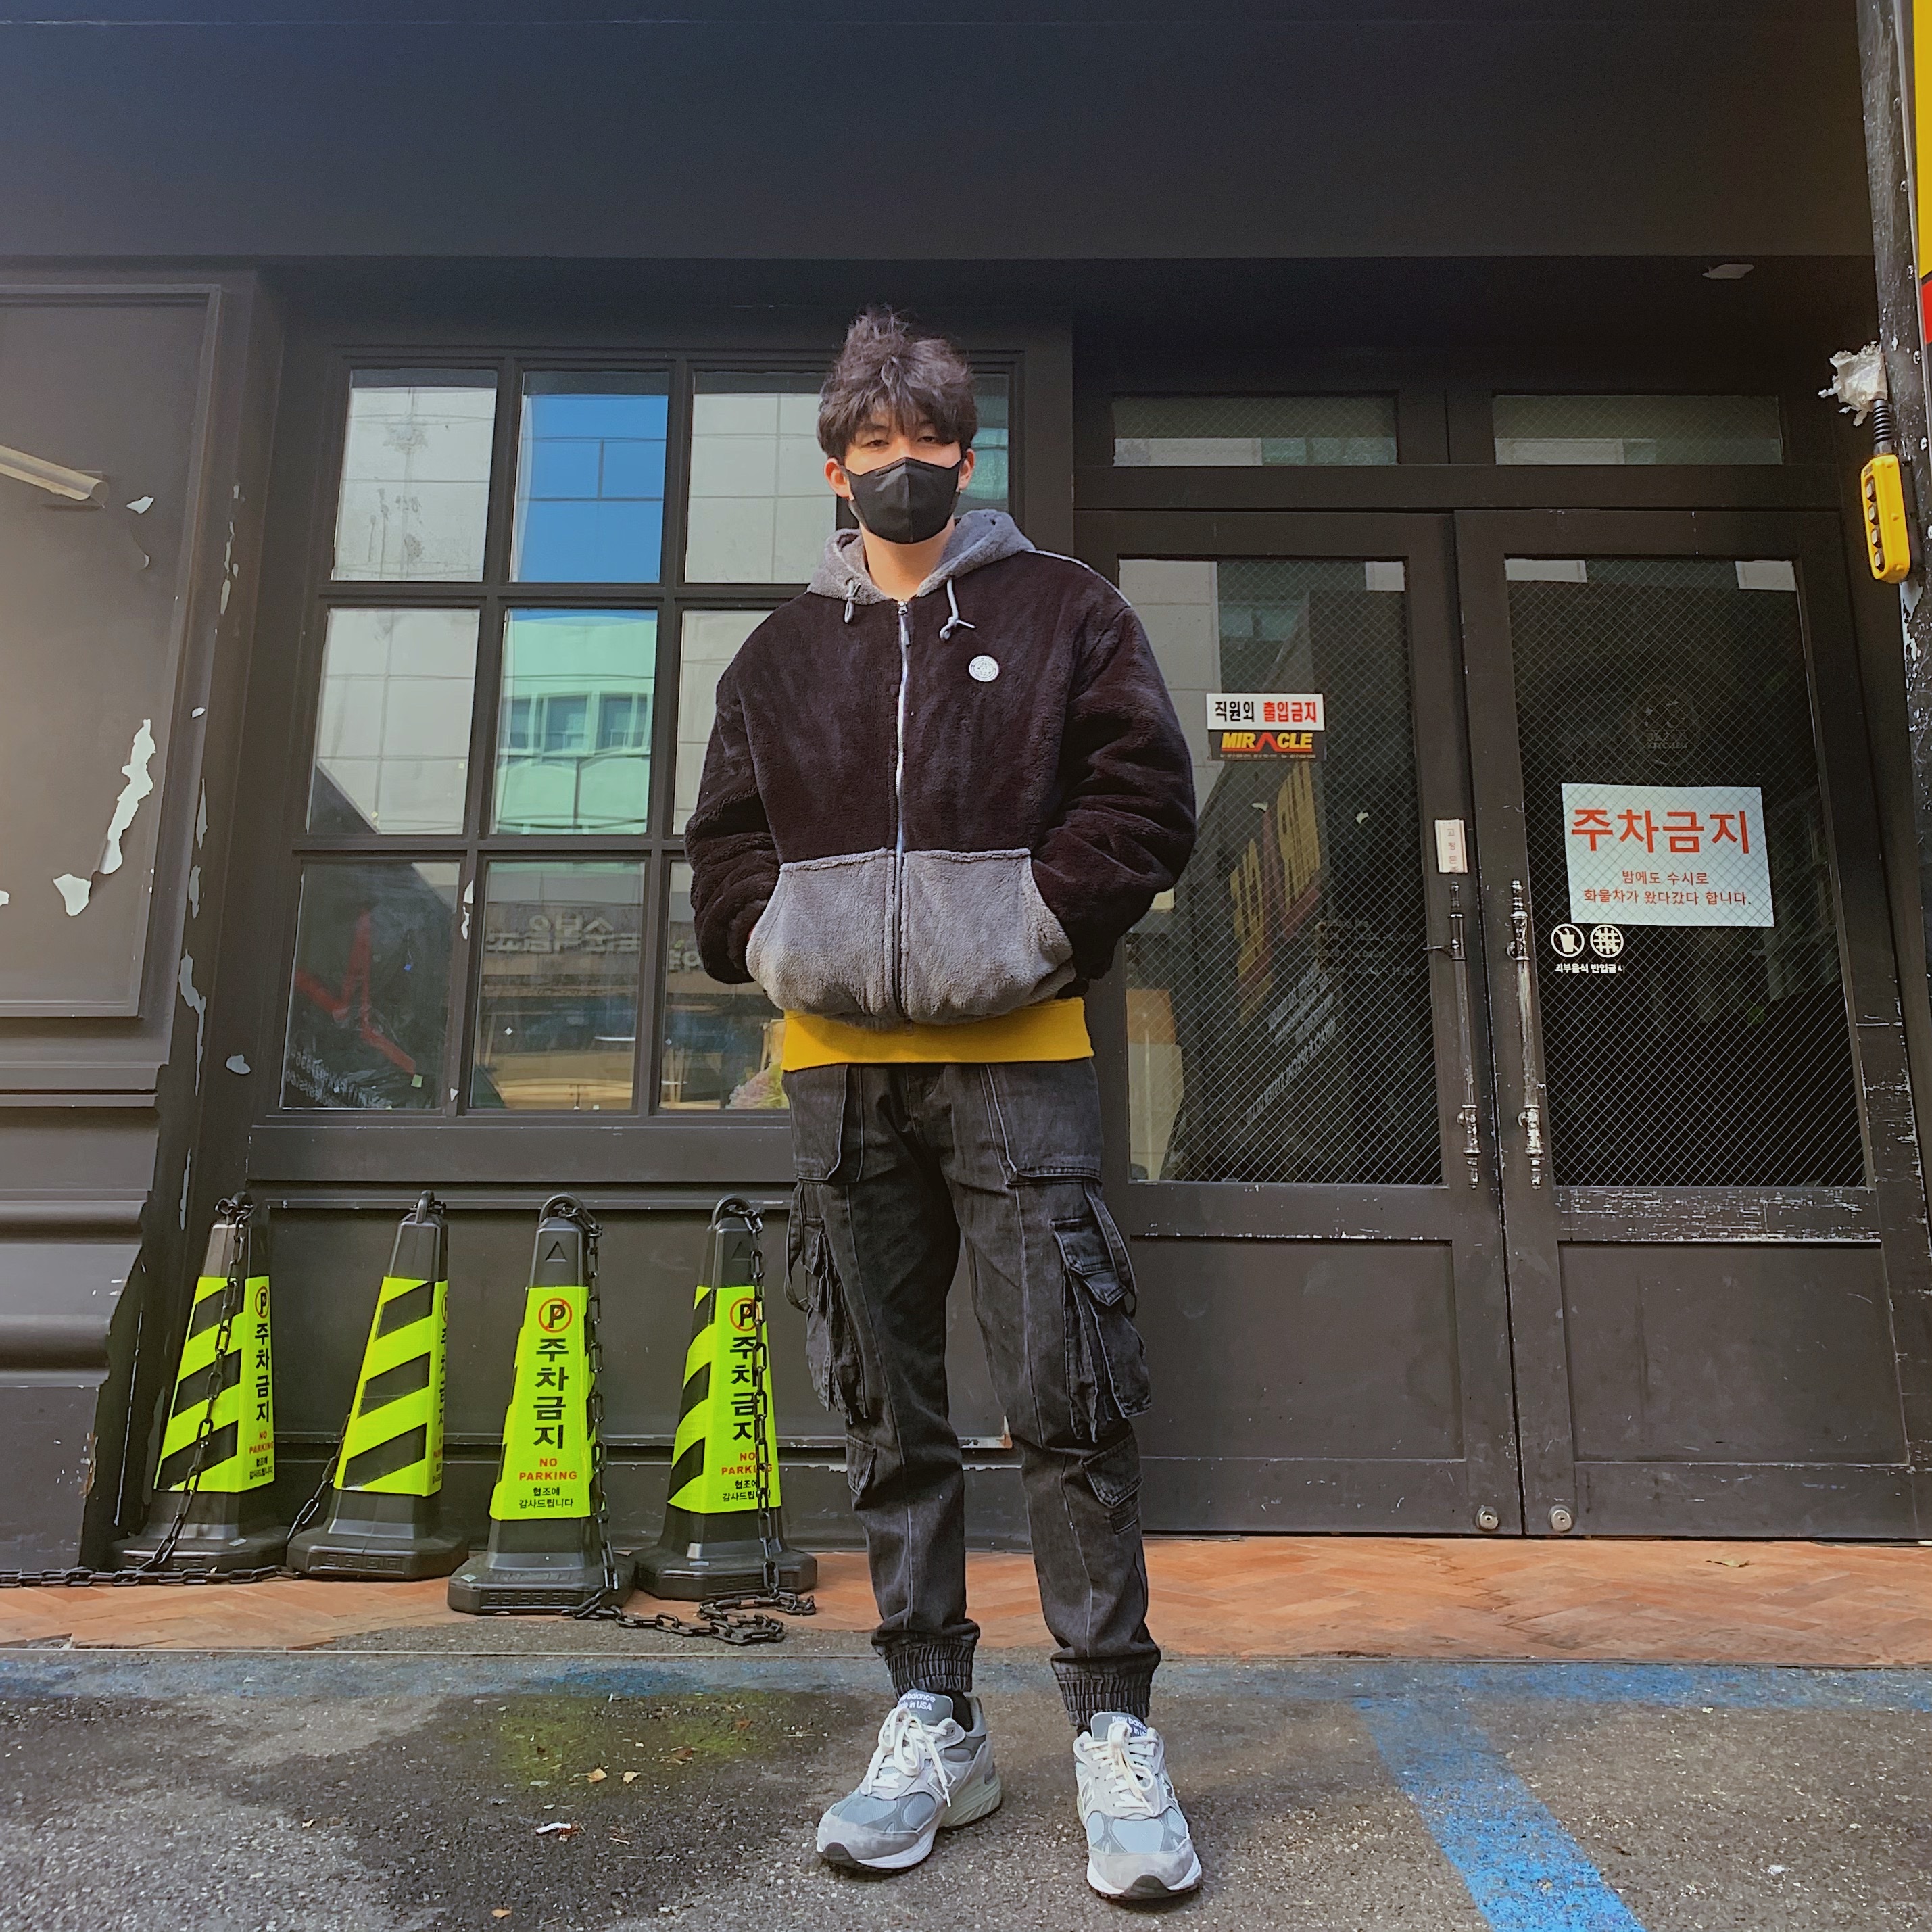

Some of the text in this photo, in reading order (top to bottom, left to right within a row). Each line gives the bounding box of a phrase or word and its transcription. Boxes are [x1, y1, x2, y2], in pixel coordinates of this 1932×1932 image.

[1215, 701, 1317, 723] 직원외 출입금지
[1221, 732, 1313, 752] MIRACLE
[1571, 809, 1749, 854] 주차금지
[1622, 870, 1710, 886] 밤에도 수시로
[1583, 888, 1639, 904] 화물차가
[1643, 890, 1699, 906] 왔다갔다
[254, 1322, 270, 1423] 주차금지
[532, 1338, 569, 1449] 주차금지
[539, 1457, 558, 1467] NO
[740, 1452, 756, 1461] NO
[518, 1471, 577, 1481] PARKING
[533, 1487, 560, 1497] 협조에
[518, 1497, 573, 1509] 감사드립니다
[907, 1692, 936, 1703] balance
[909, 1700, 915, 1708] in
[916, 1701, 932, 1711] USA
